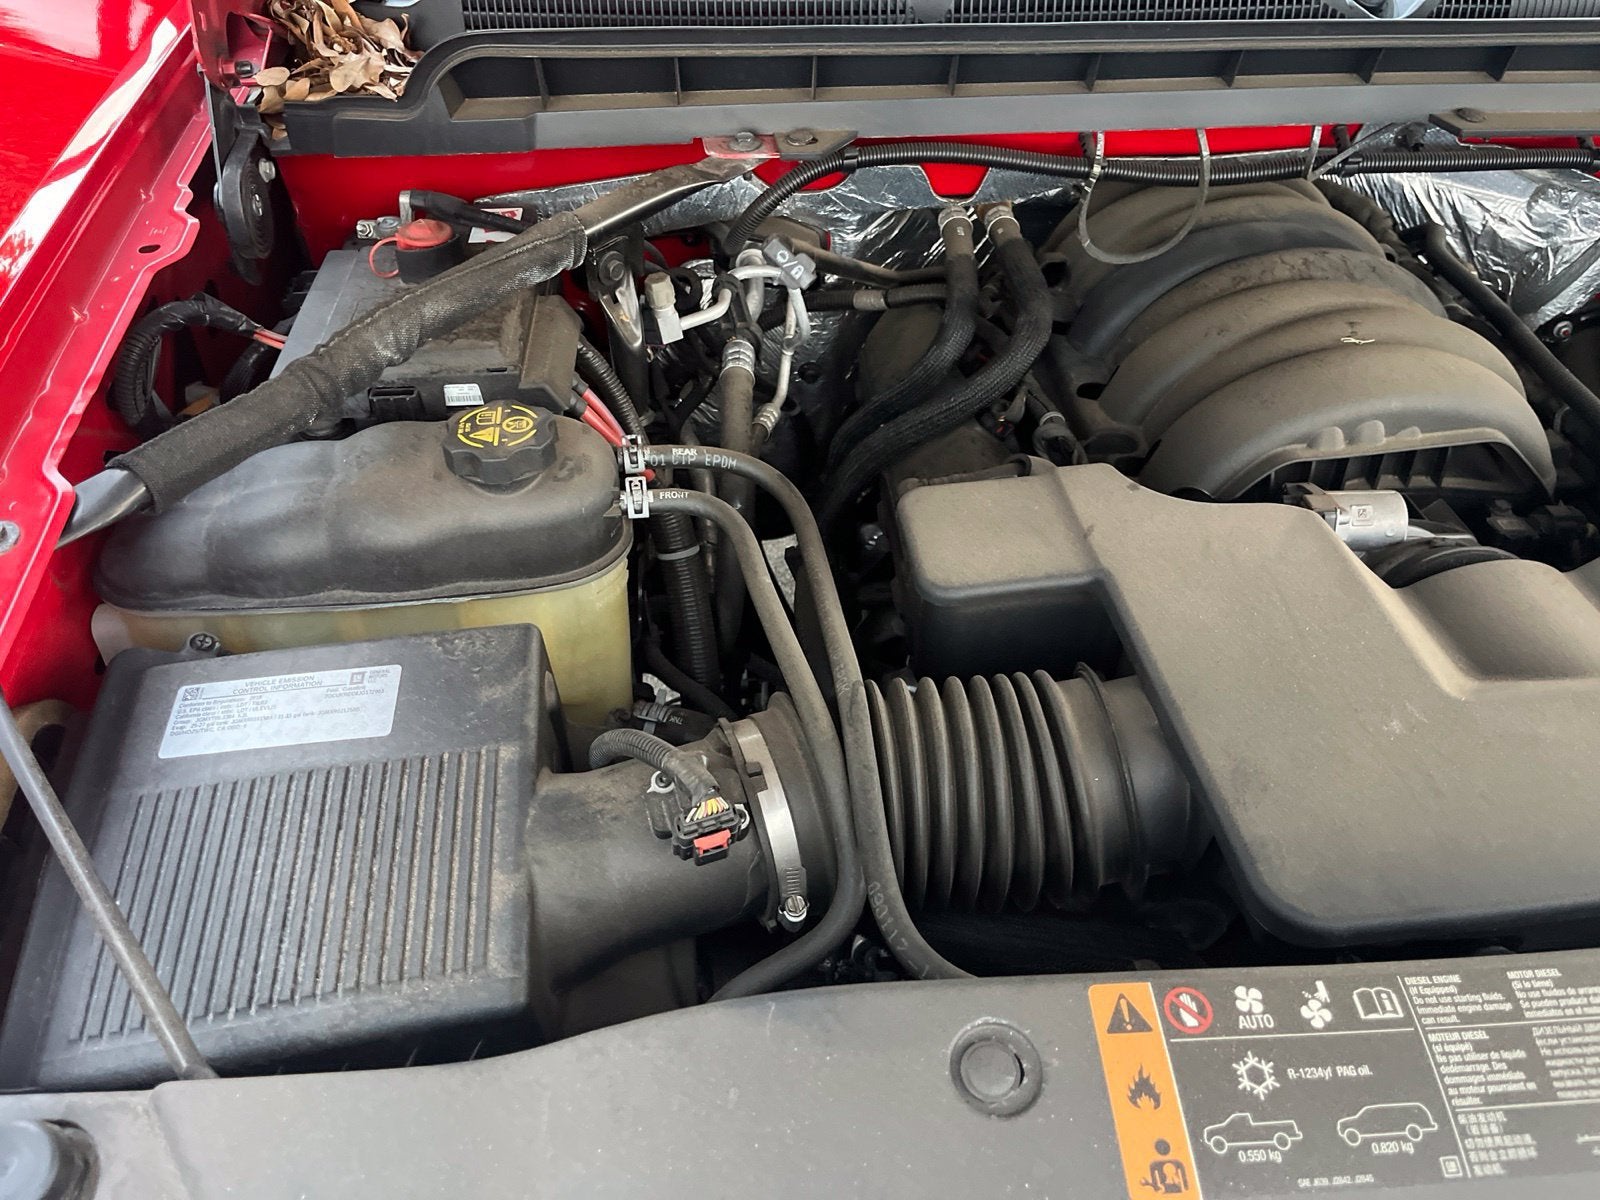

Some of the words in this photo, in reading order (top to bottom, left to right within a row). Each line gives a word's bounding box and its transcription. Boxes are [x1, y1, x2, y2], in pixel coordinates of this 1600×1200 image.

[672, 448, 697, 456] REAR
[705, 454, 737, 469] EPDM
[660, 491, 689, 499] FRONT
[232, 686, 268, 695] CONTROL
[271, 680, 322, 691] INFORMATION
[245, 679, 276, 687] VEHICLE
[1506, 969, 1534, 979] MOTOR
[1534, 968, 1562, 977] DIESEL
[1404, 976, 1432, 985] DIESEL
[1432, 975, 1461, 984] ENGINE
[1419, 984, 1457, 996] Equipped)
[1412, 996, 1424, 1004] Do
[1424, 995, 1438, 1004] not
[1453, 994, 1482, 1003] starting
[1457, 1004, 1482, 1014] engine
[1238, 1013, 1274, 1029] AUTO
[1427, 1032, 1461, 1042] MOTEUR
[1287, 1066, 1333, 1080] R-1234yf
[1336, 1066, 1357, 1077] PAG
[1358, 1064, 1373, 1076] oil.
[1371, 1142, 1399, 1154] 0.820
[1400, 1141, 1414, 1154] kg
[1238, 1151, 1267, 1163] 0.550
[1268, 1150, 1282, 1163] kg
